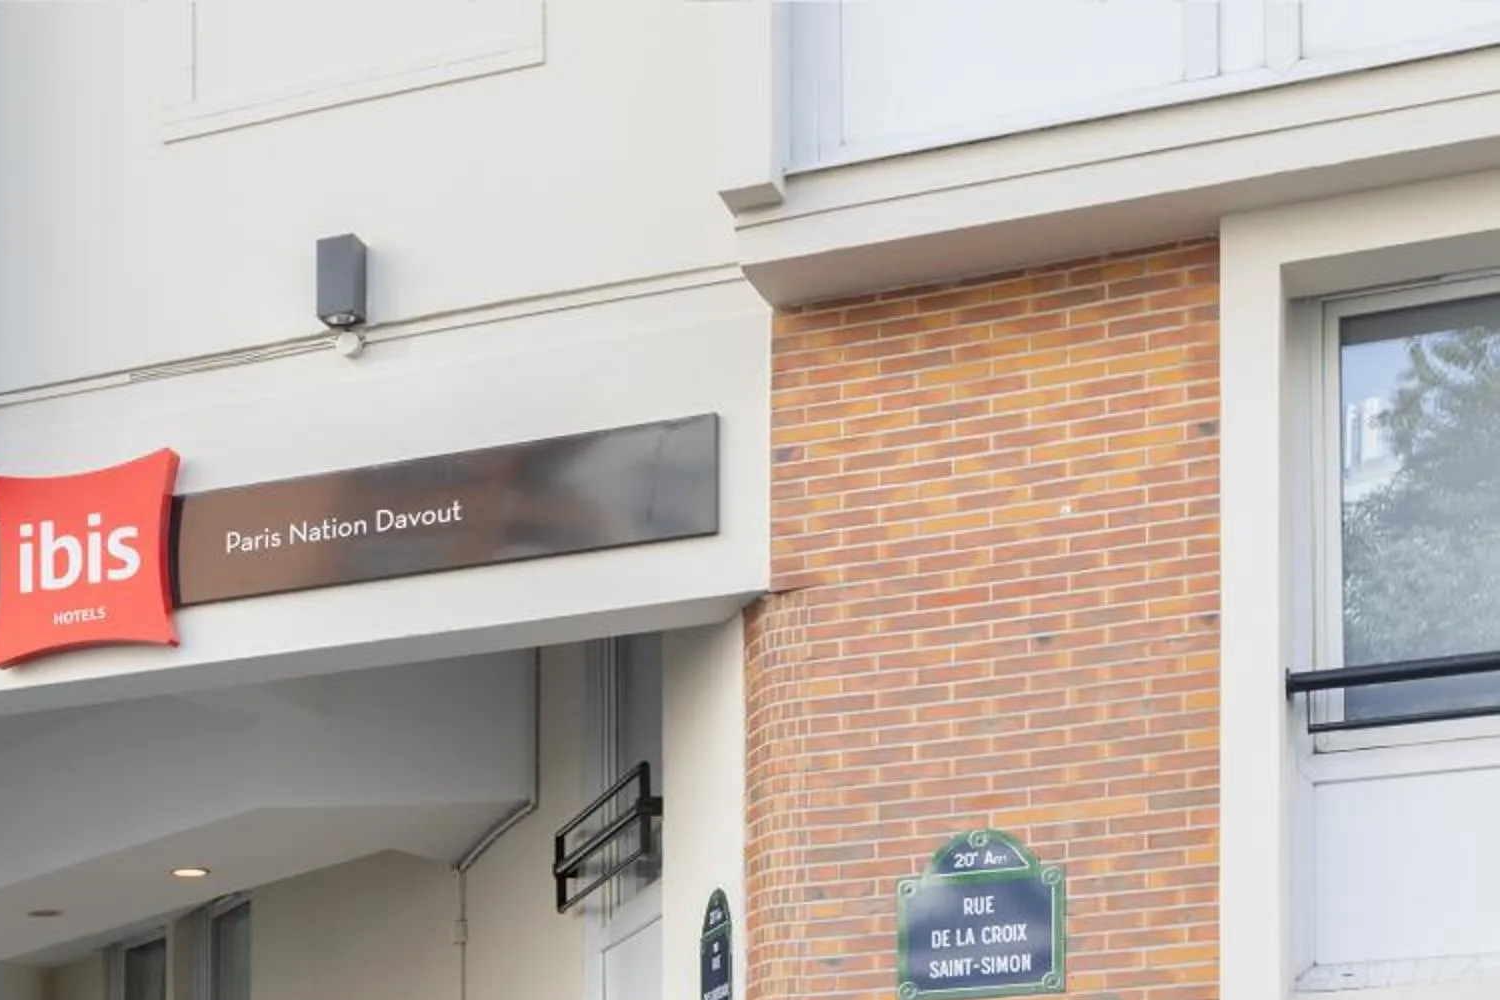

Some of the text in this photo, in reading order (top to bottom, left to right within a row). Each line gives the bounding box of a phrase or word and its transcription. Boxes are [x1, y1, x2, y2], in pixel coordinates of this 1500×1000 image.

[225, 500, 463, 554] Paris Nation Davout
[19, 511, 141, 594] ibis
[52, 605, 107, 626] HOTELS
[963, 895, 995, 916] RUE
[931, 923, 1028, 949] DE LA CROIX
[928, 952, 1032, 979] SAINT-SIMON
